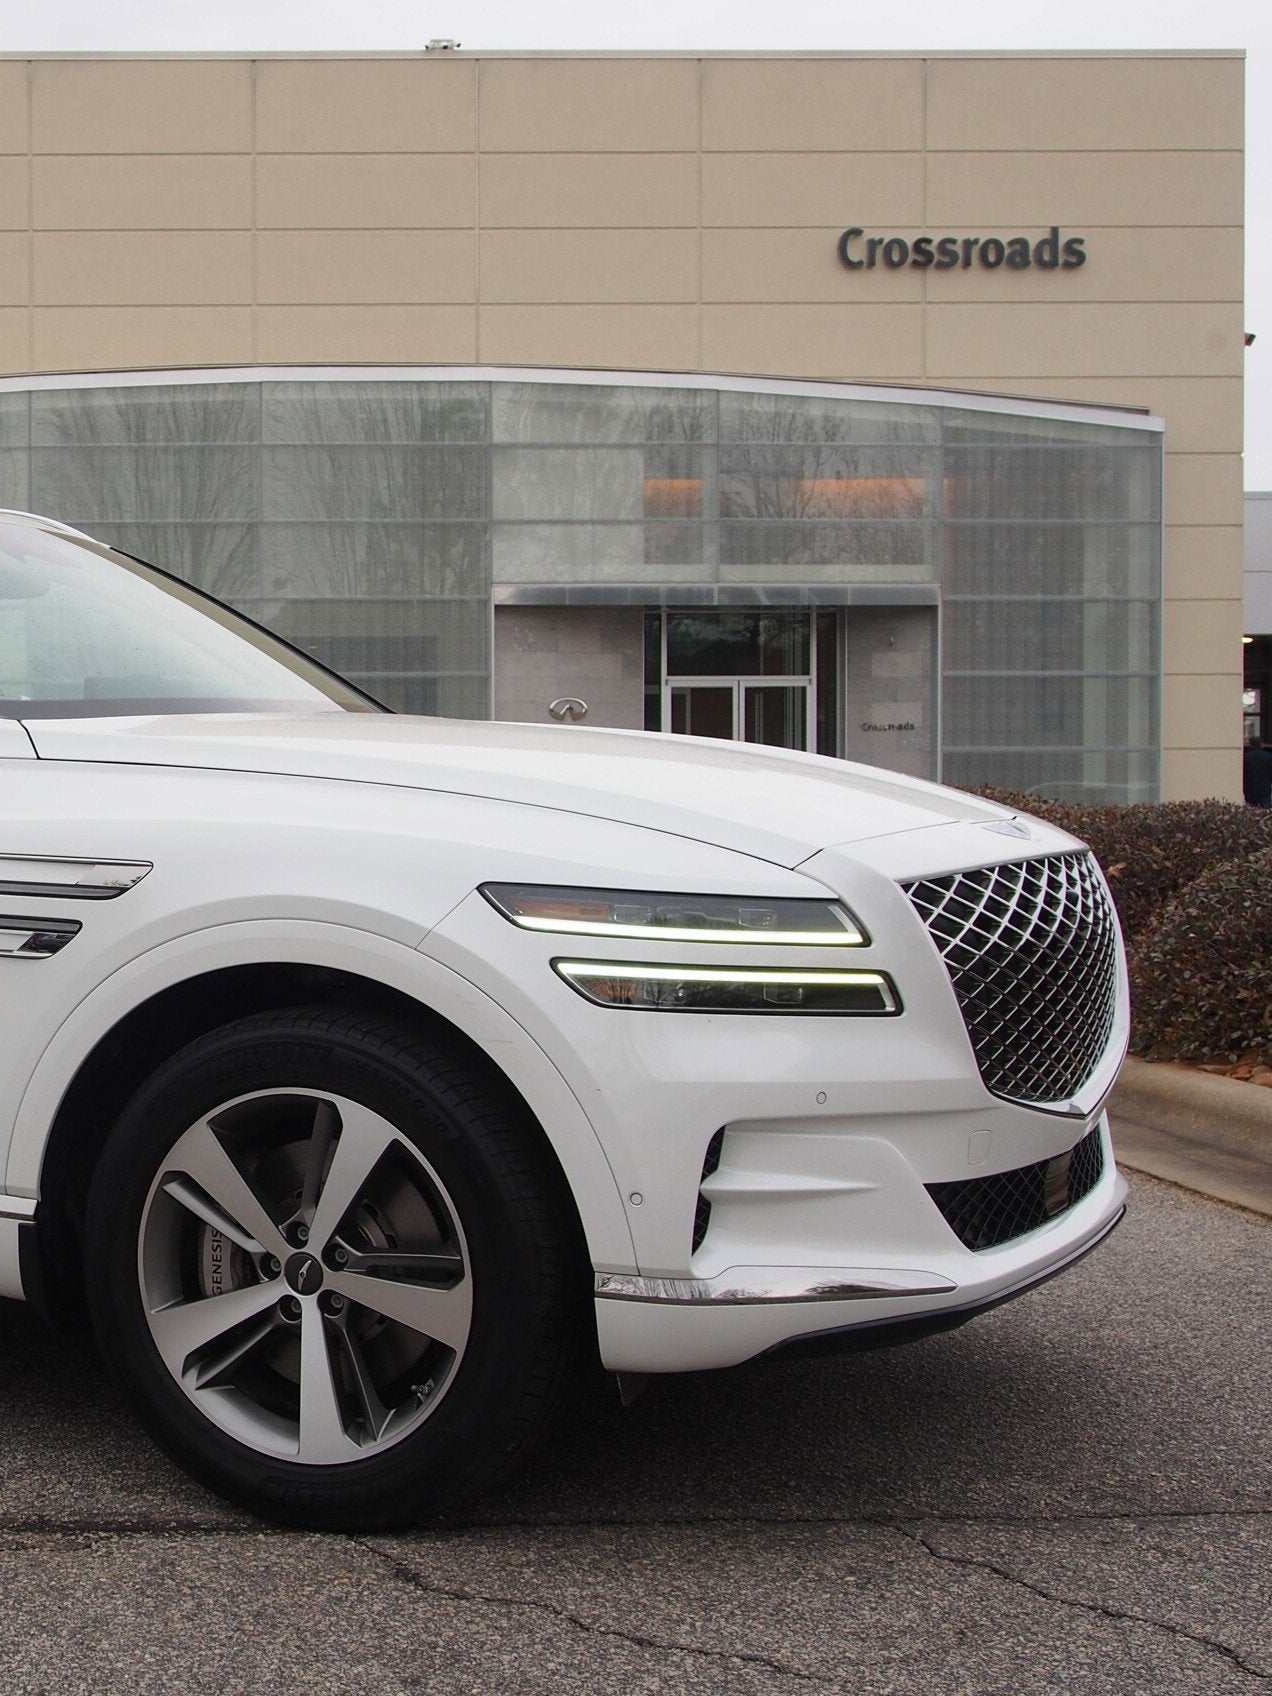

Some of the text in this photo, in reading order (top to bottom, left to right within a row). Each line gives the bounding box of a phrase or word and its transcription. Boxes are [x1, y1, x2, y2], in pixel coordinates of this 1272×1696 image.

[837, 226, 1087, 270] Crossroads
[861, 721, 915, 731] Crorads
[426, 1113, 449, 1133] 20
[211, 1229, 223, 1296] GENESIS
